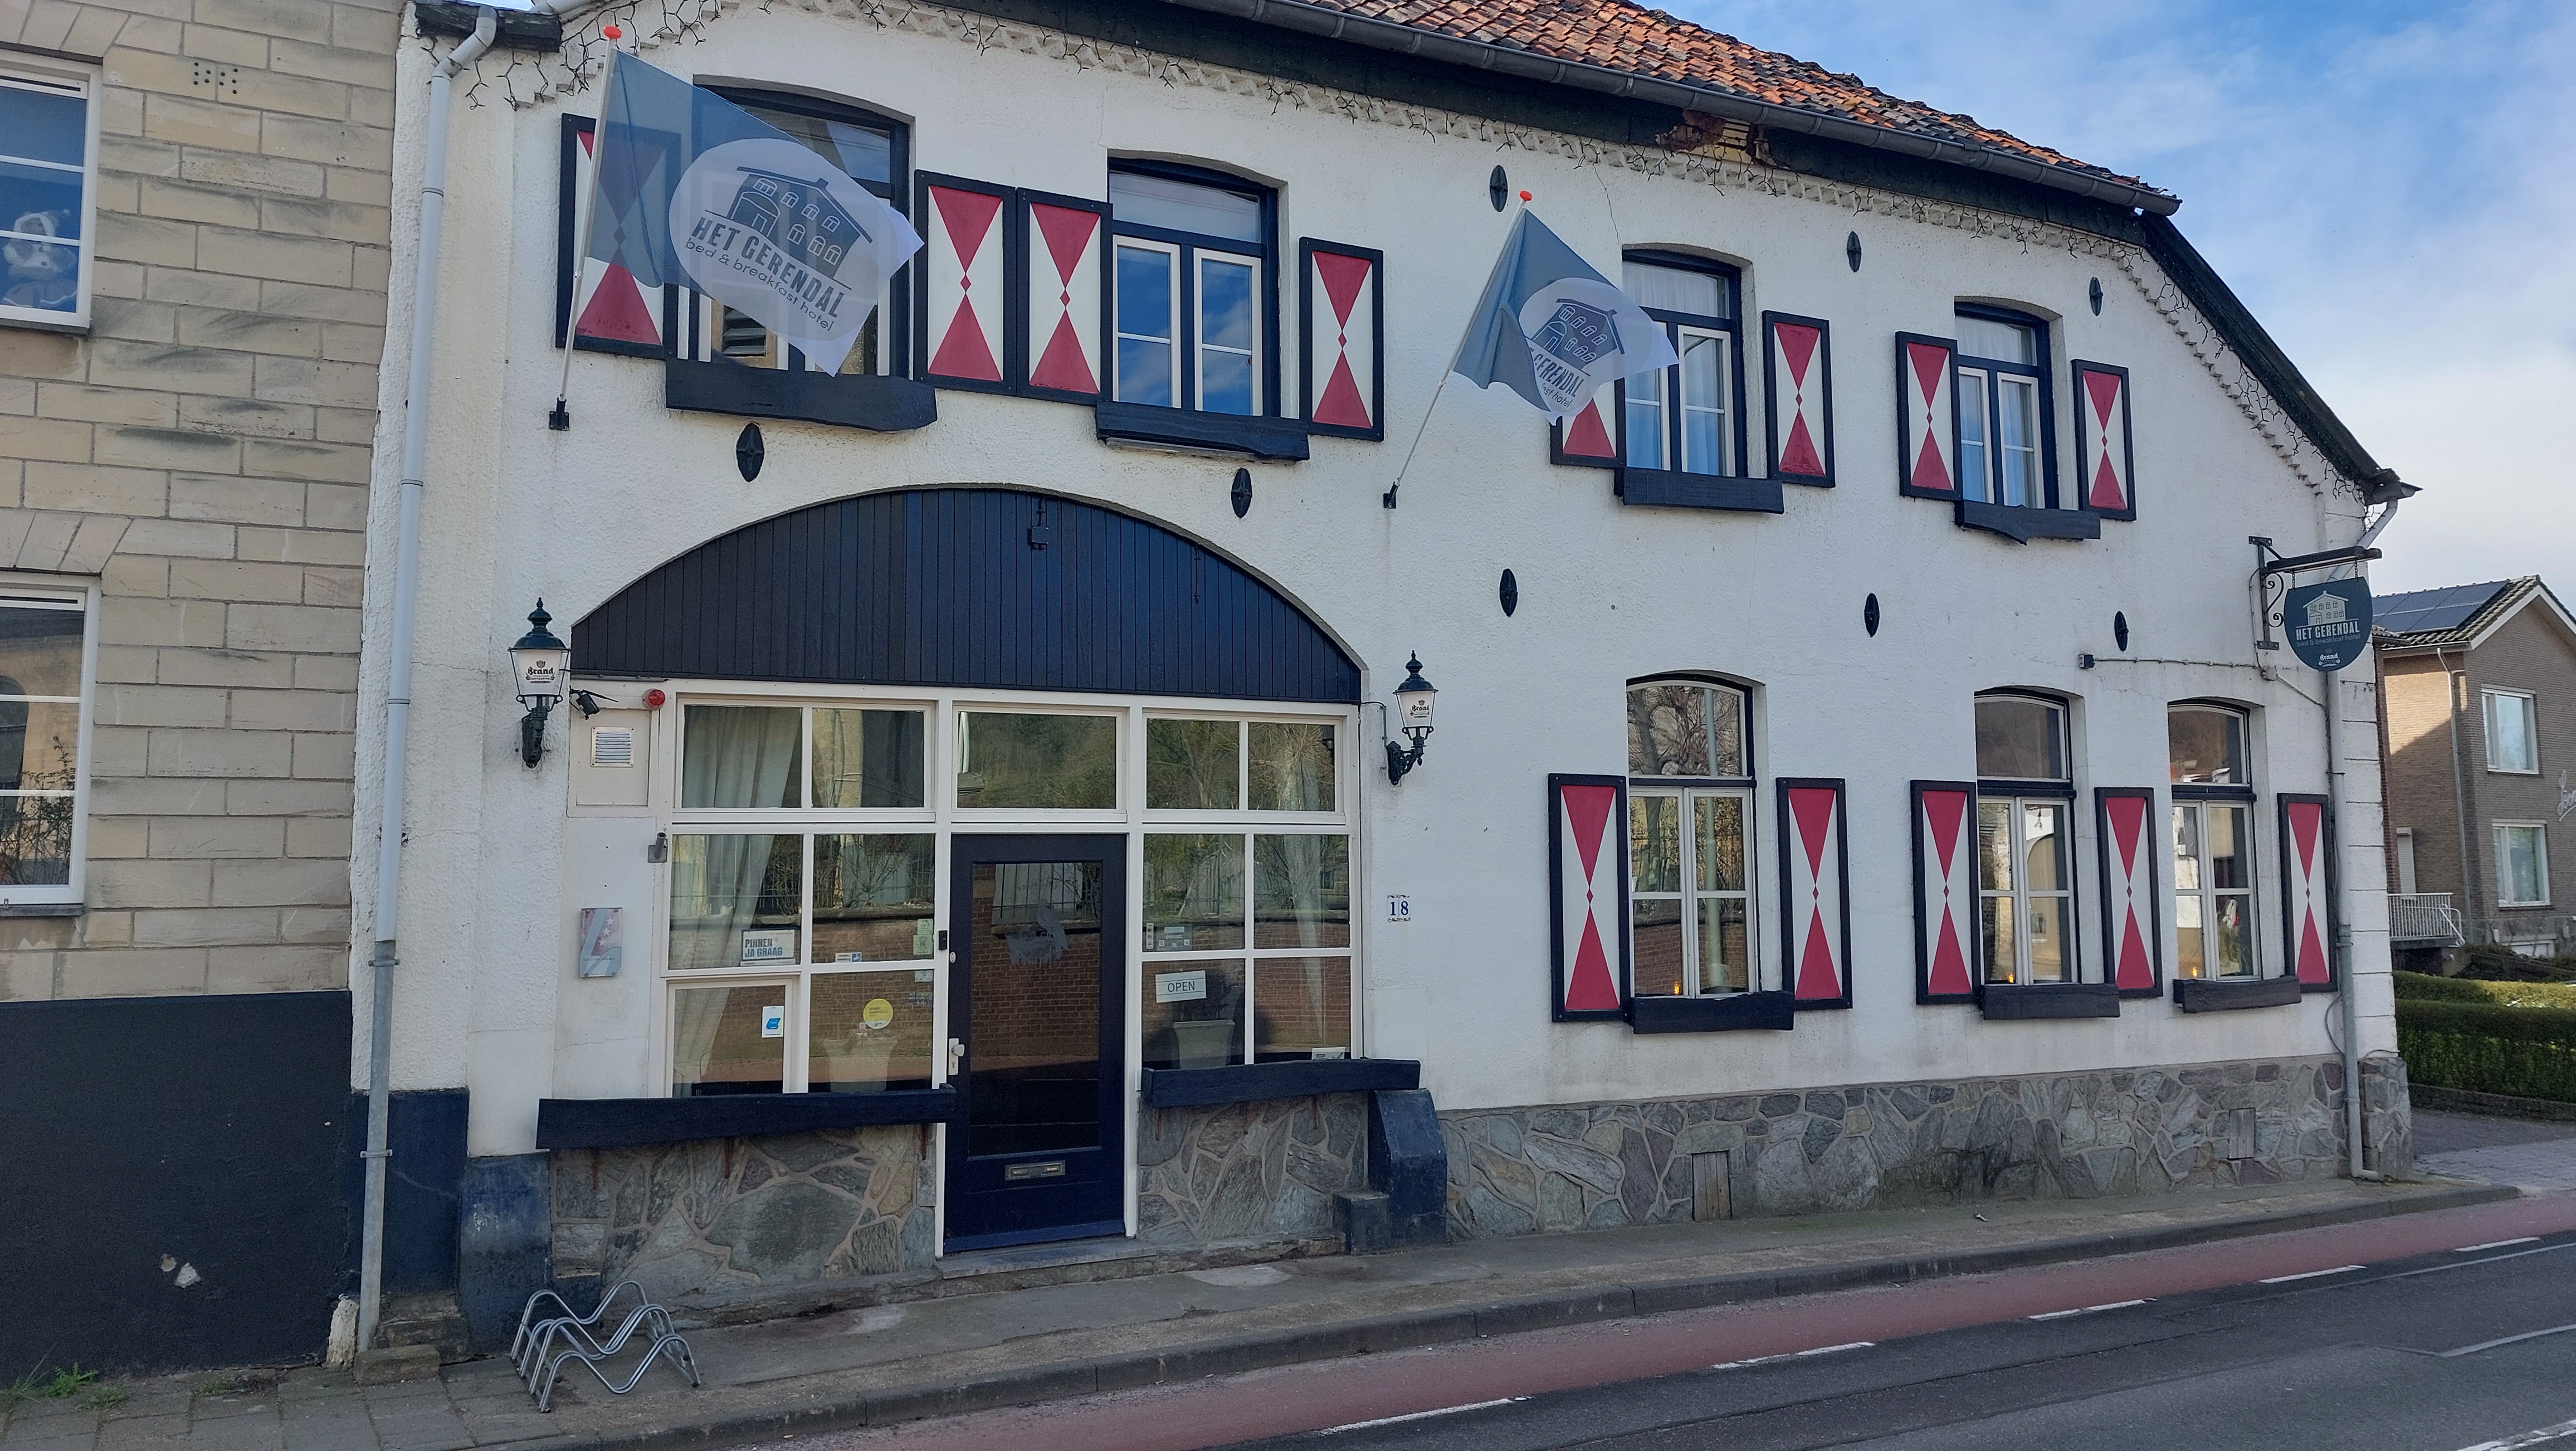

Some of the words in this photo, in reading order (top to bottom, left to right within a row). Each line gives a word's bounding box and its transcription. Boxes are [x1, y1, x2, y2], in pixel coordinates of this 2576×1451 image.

[691, 217, 741, 251] HET
[741, 236, 845, 319] GERENDAL
[685, 237, 717, 258] bed
[719, 254, 730, 266] &
[733, 258, 799, 304] breakfast
[800, 301, 835, 332] hotel
[1552, 391, 1573, 408] hotel
[2296, 627, 2312, 641] HET
[2315, 621, 2360, 639] GERENDAL
[2315, 636, 2344, 645] breakfast
[2320, 653, 2339, 661] Brand
[528, 666, 554, 675] Brand
[1390, 900, 1408, 916] 18
[745, 938, 773, 948] PINNEN
[745, 948, 755, 957] JA
[757, 947, 782, 957] GRAAG
[1167, 981, 1195, 992] OPEN
